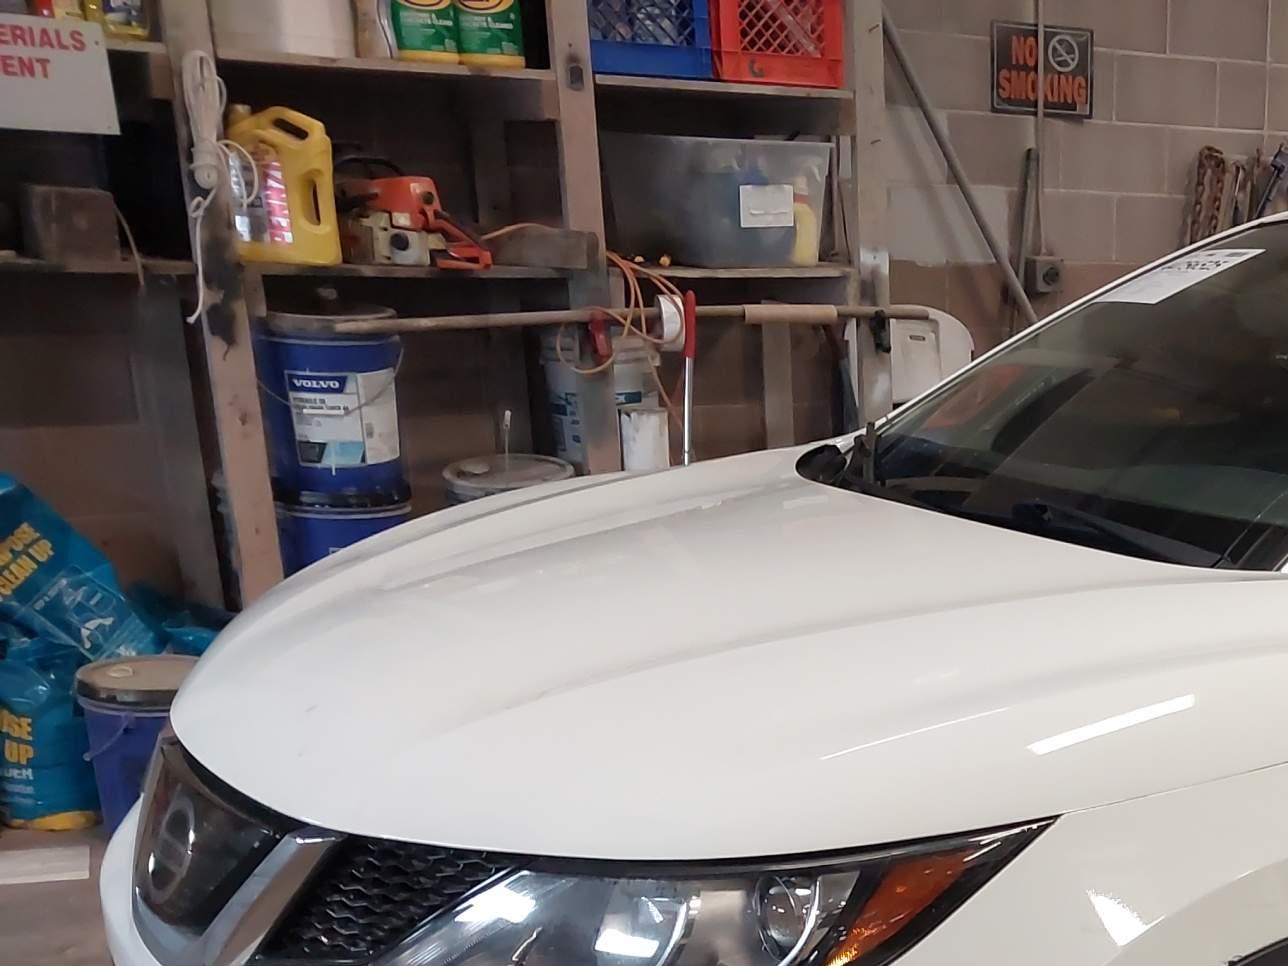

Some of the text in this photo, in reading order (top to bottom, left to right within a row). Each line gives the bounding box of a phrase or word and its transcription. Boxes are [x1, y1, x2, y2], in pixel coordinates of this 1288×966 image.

[0, 23, 87, 52] ERIALS
[1010, 34, 1038, 66] NO
[291, 378, 340, 390] VOLVO
[4, 740, 34, 766] UP
